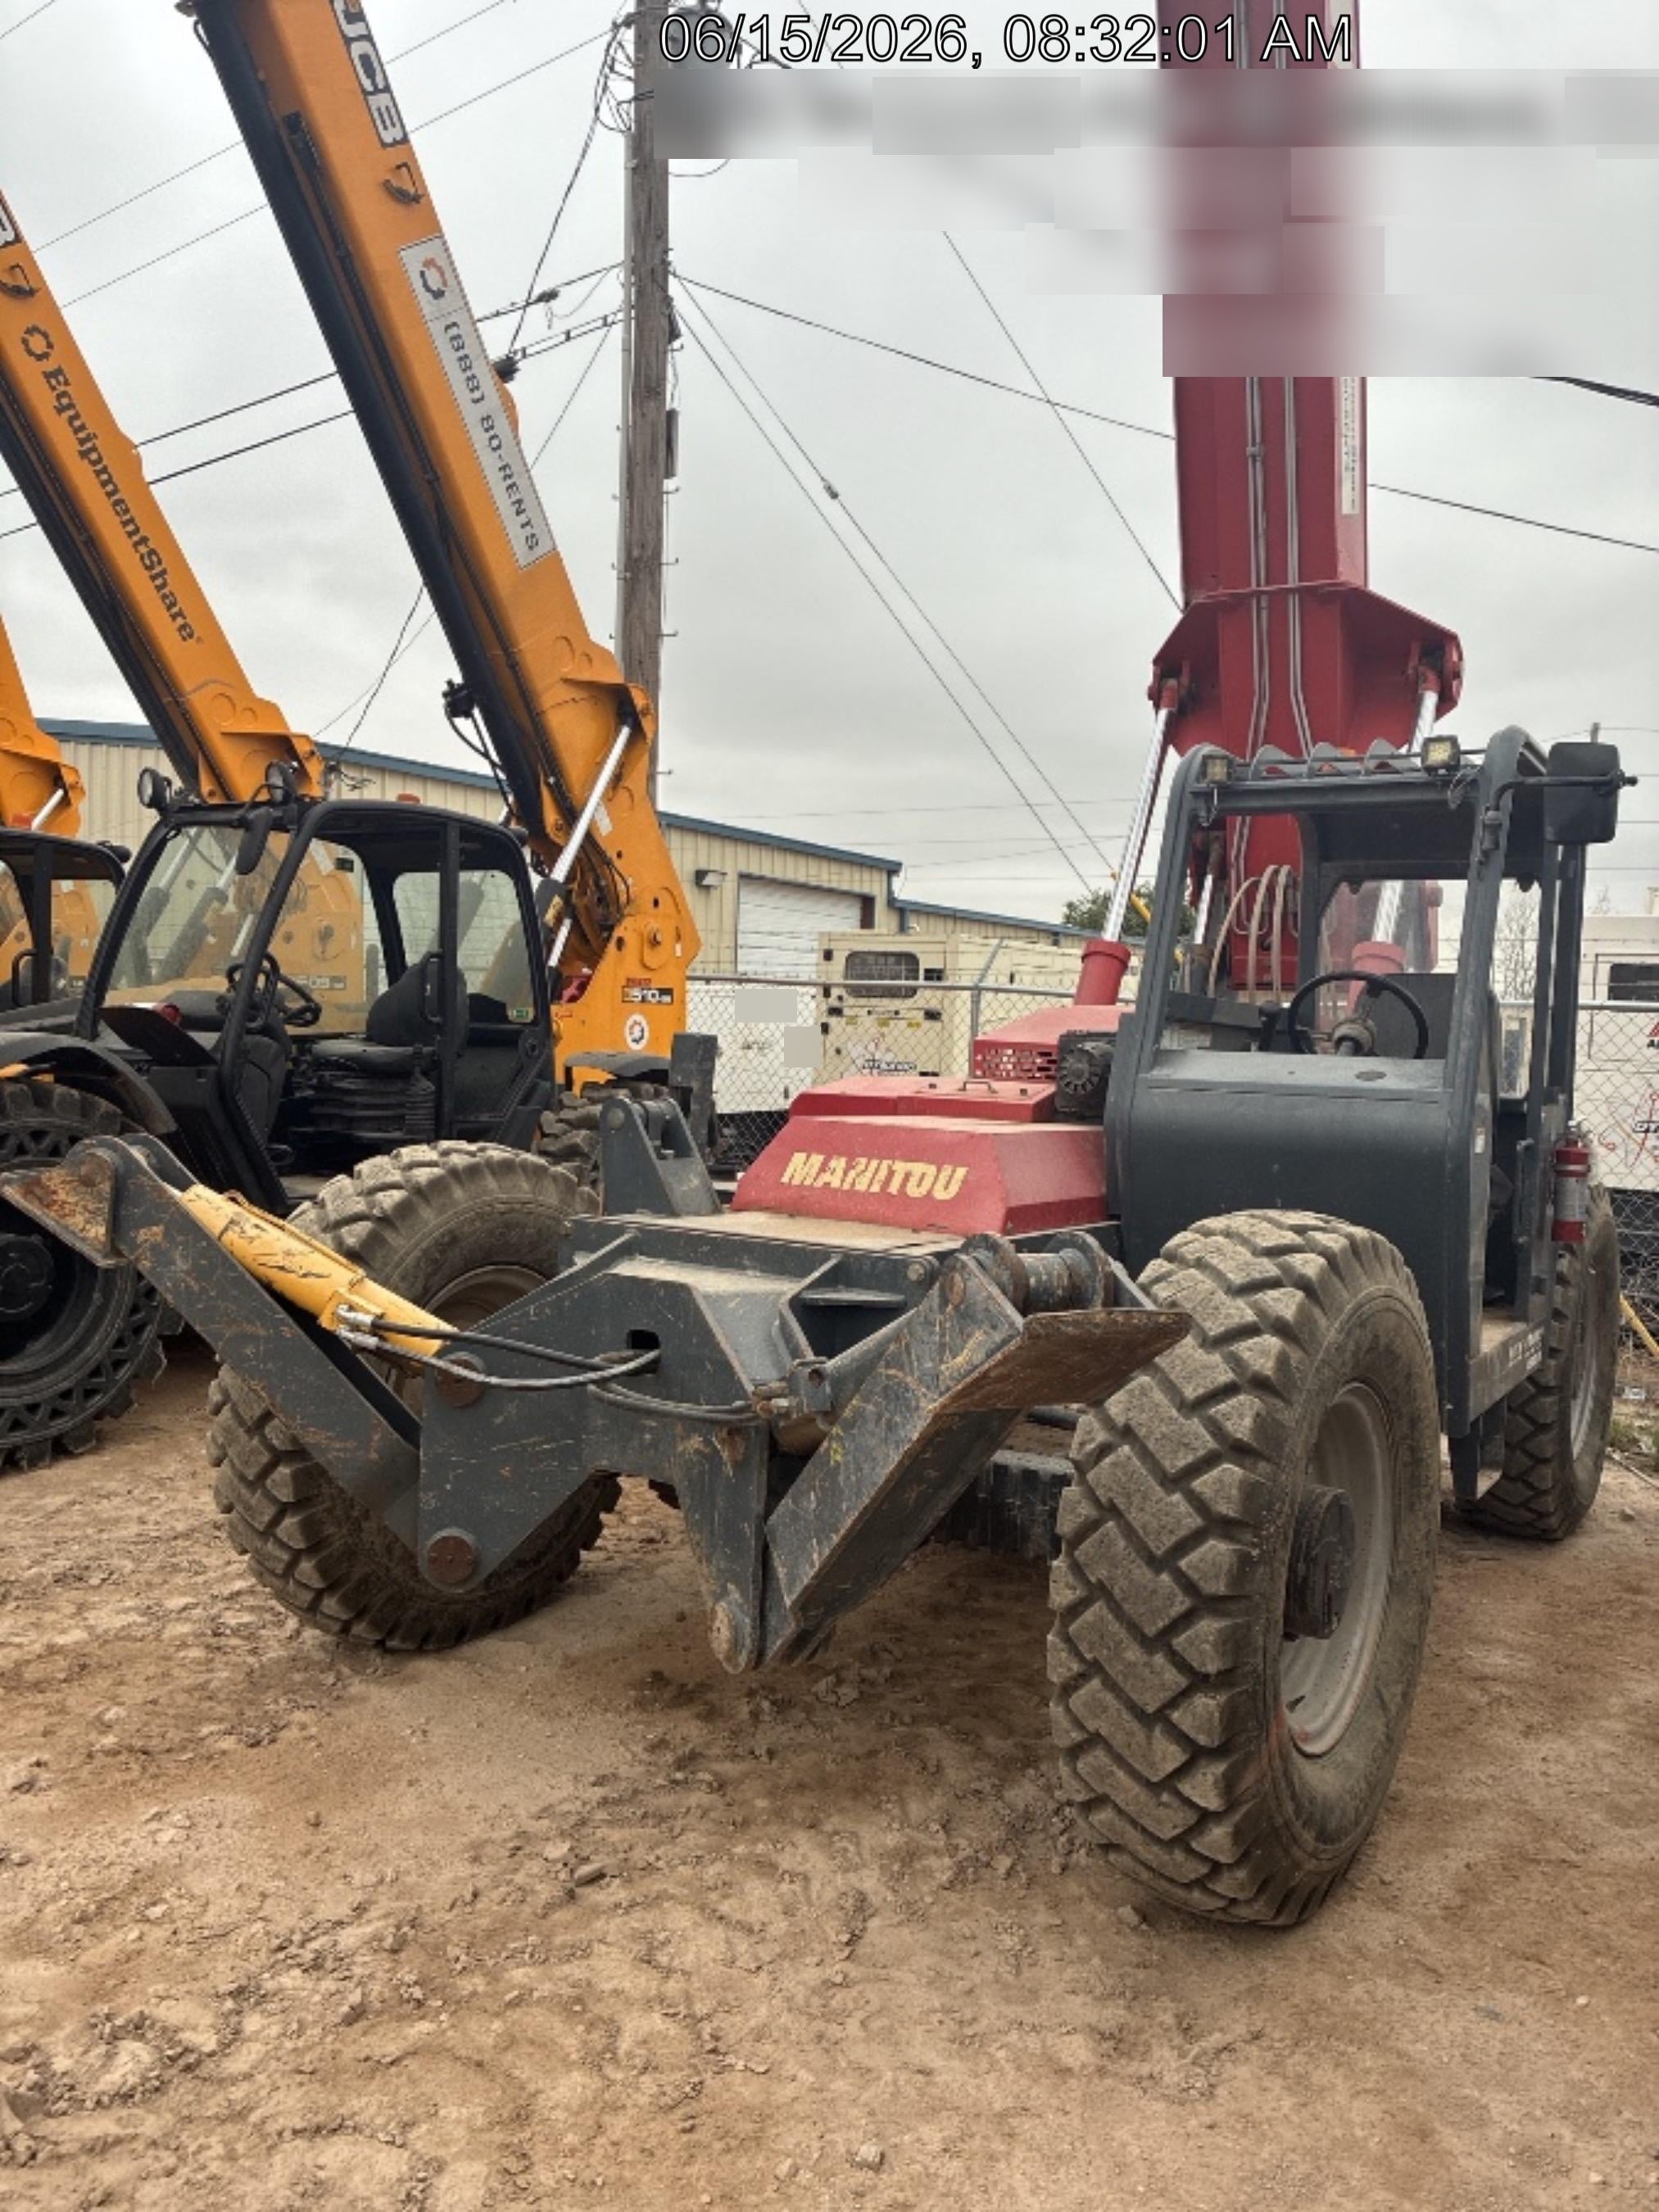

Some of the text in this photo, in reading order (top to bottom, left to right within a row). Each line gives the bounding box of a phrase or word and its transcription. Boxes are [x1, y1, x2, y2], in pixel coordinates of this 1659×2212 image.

[333, 0, 406, 143] JCB
[42, 364, 195, 642] EquipmentShare
[445, 321, 539, 551] (888) 80-RENTS
[780, 1152, 970, 1200] MANITOU
